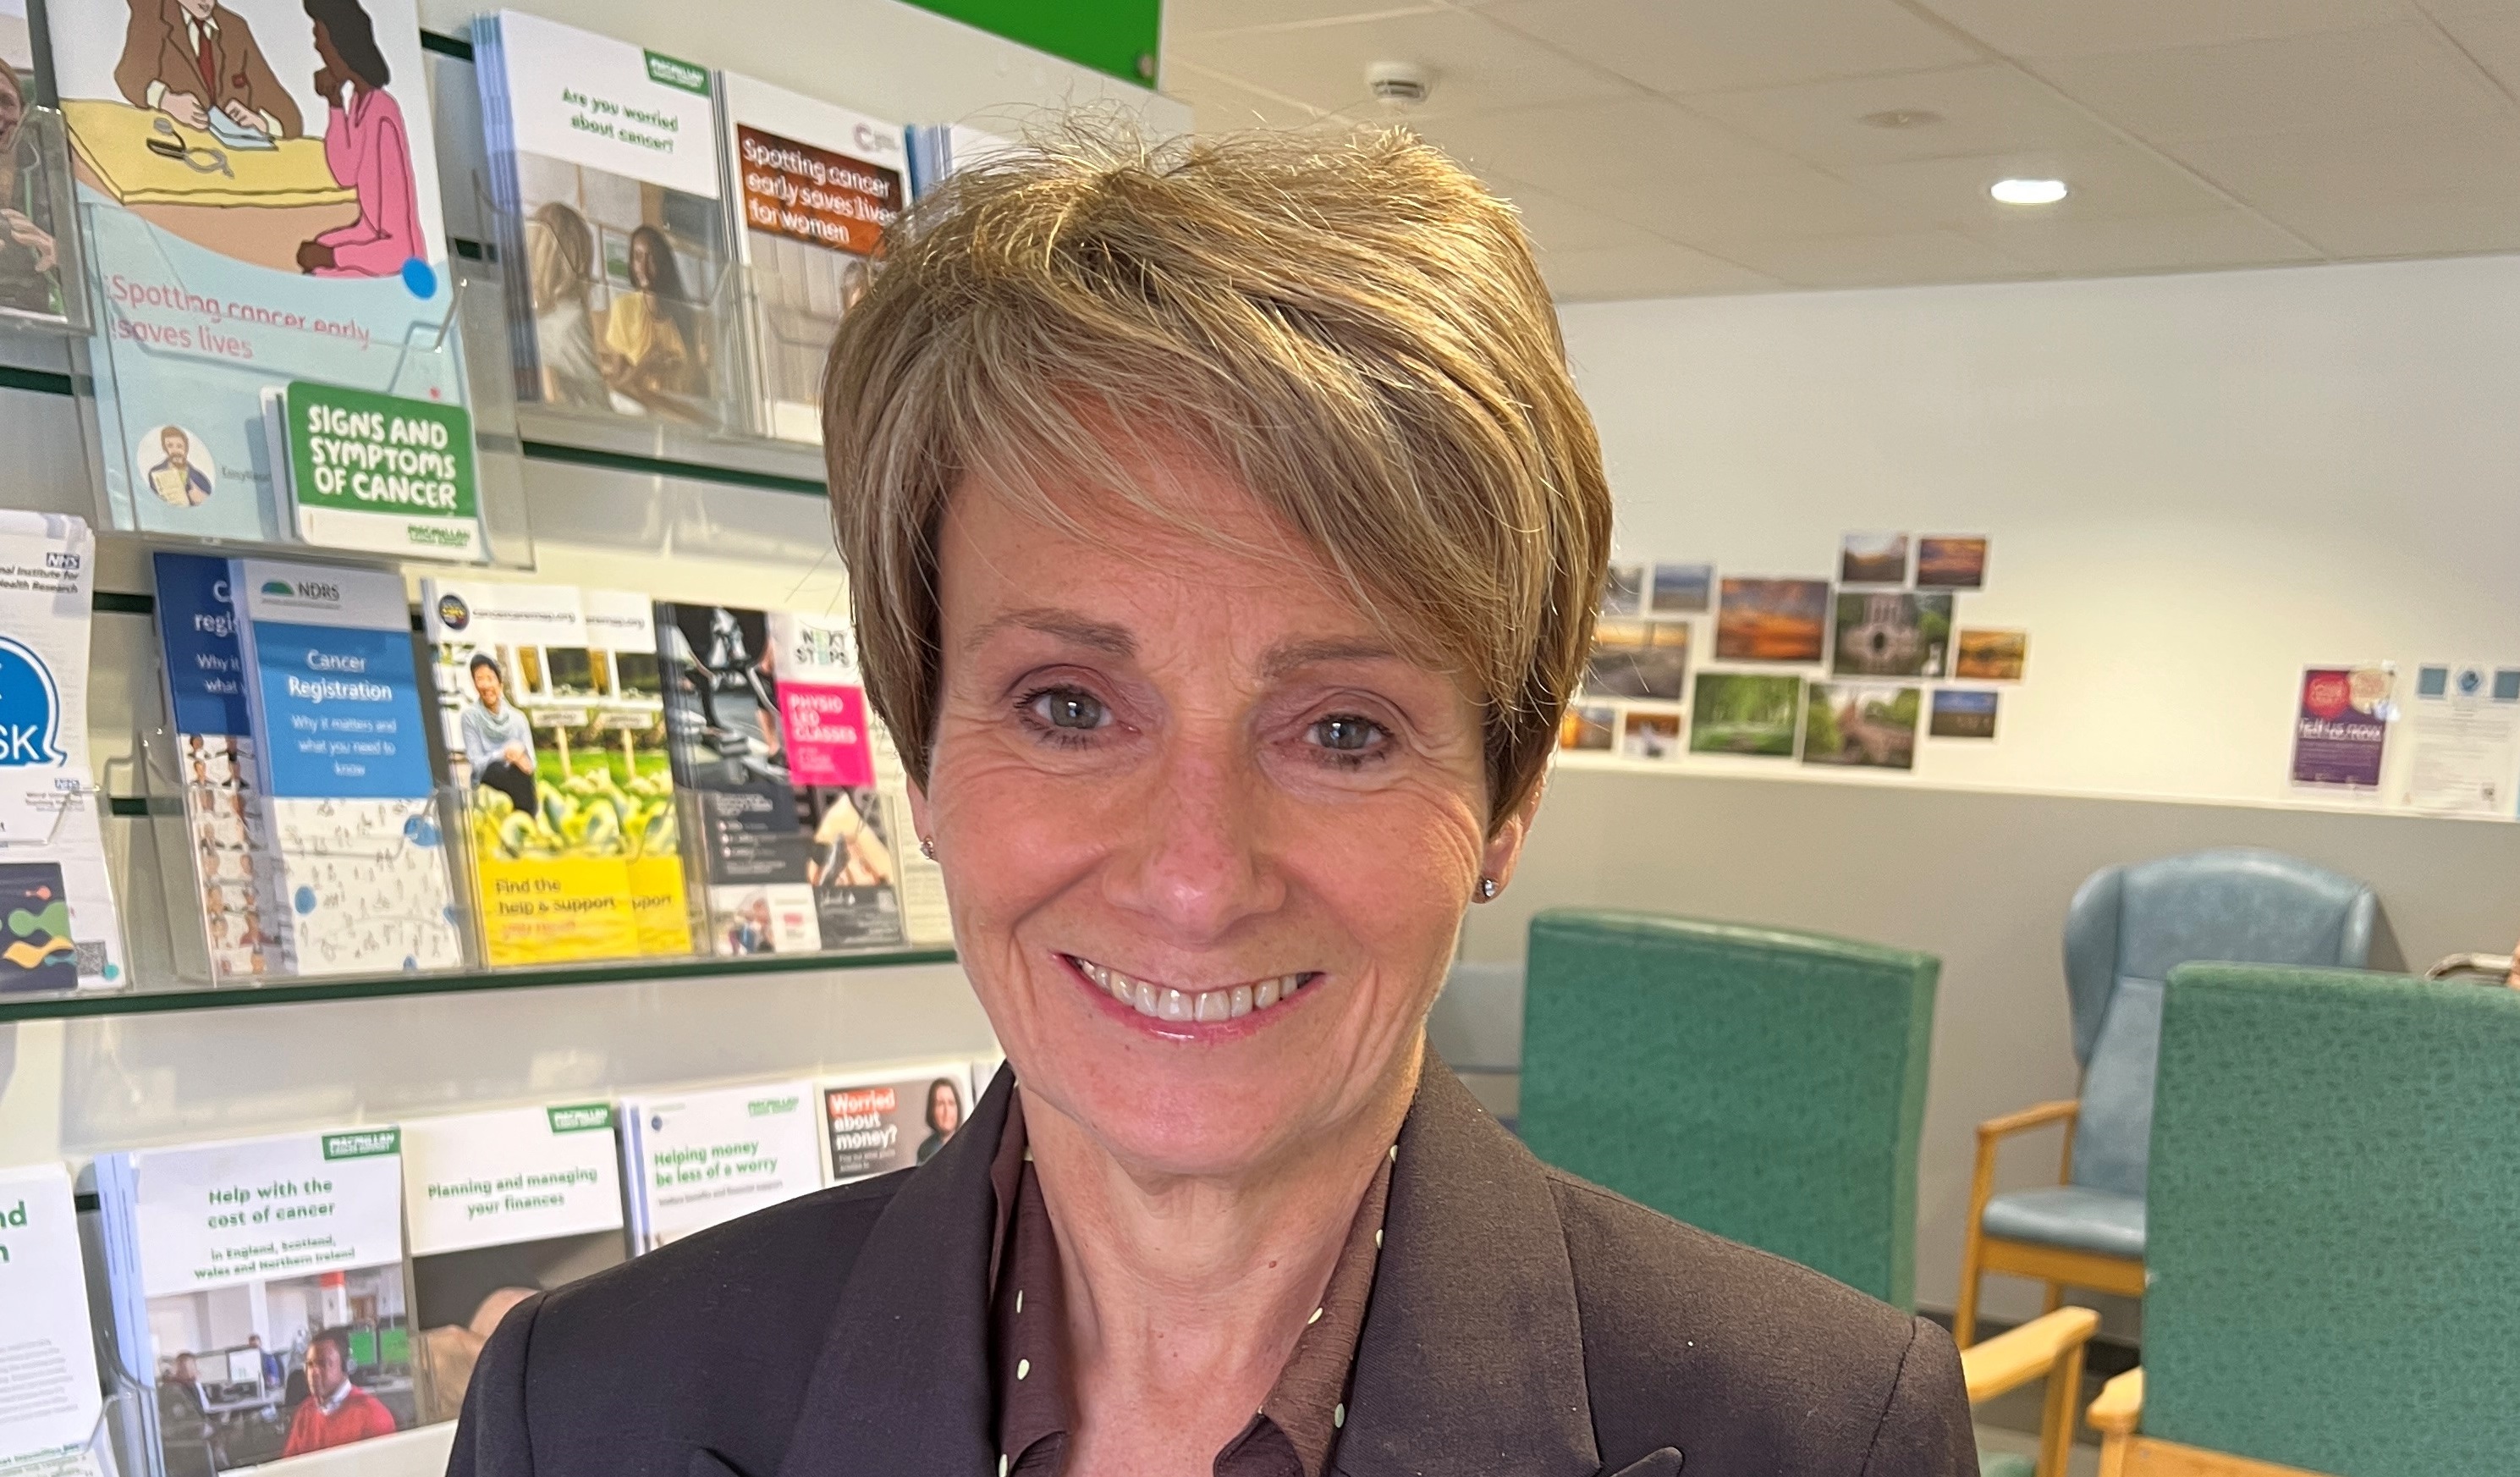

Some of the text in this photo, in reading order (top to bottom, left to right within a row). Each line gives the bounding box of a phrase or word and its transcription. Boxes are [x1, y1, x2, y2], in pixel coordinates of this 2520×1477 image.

[562, 86, 679, 132] Are you worried
[571, 113, 614, 138] about
[743, 138, 889, 199] Spotting cancer
[746, 173, 898, 227] early saves lives
[749, 198, 850, 244] for women
[112, 274, 370, 351] Spotting cancer early
[119, 319, 254, 359] saves lives
[308, 405, 448, 450] SIGNS AND
[310, 436, 456, 480] SYMPTOMS
[315, 466, 457, 510] OF CANCER
[18, 566, 61, 578] Institute
[63, 570, 79, 580] for
[47, 553, 80, 570] NHS
[32, 580, 78, 592] Research
[298, 581, 340, 600] NDRS
[802, 630, 845, 648] NXT
[195, 653, 227, 672] Why
[307, 648, 366, 673] Cancer
[796, 648, 850, 667] STPS
[204, 677, 238, 695] what
[288, 675, 393, 703] Registration
[788, 693, 844, 714] PHYSIO
[291, 714, 397, 734] Why it matters and
[794, 725, 857, 744] CLASSES
[299, 737, 396, 758] what you need to
[333, 760, 366, 776] know
[496, 877, 561, 894] Find the
[499, 901, 533, 916] help
[554, 896, 616, 914] support
[830, 1088, 895, 1115] Worried
[834, 1111, 881, 1133] about
[836, 1124, 897, 1151] money?
[655, 1141, 759, 1166] Helping money
[428, 1166, 597, 1199] Planning and managing
[656, 1157, 778, 1188] be less of a worry
[209, 1177, 333, 1205] Help with the
[207, 1202, 335, 1228] cost of cancer
[467, 1193, 565, 1221] your finances
[194, 1247, 355, 1281] Wales and Northern Ireland
